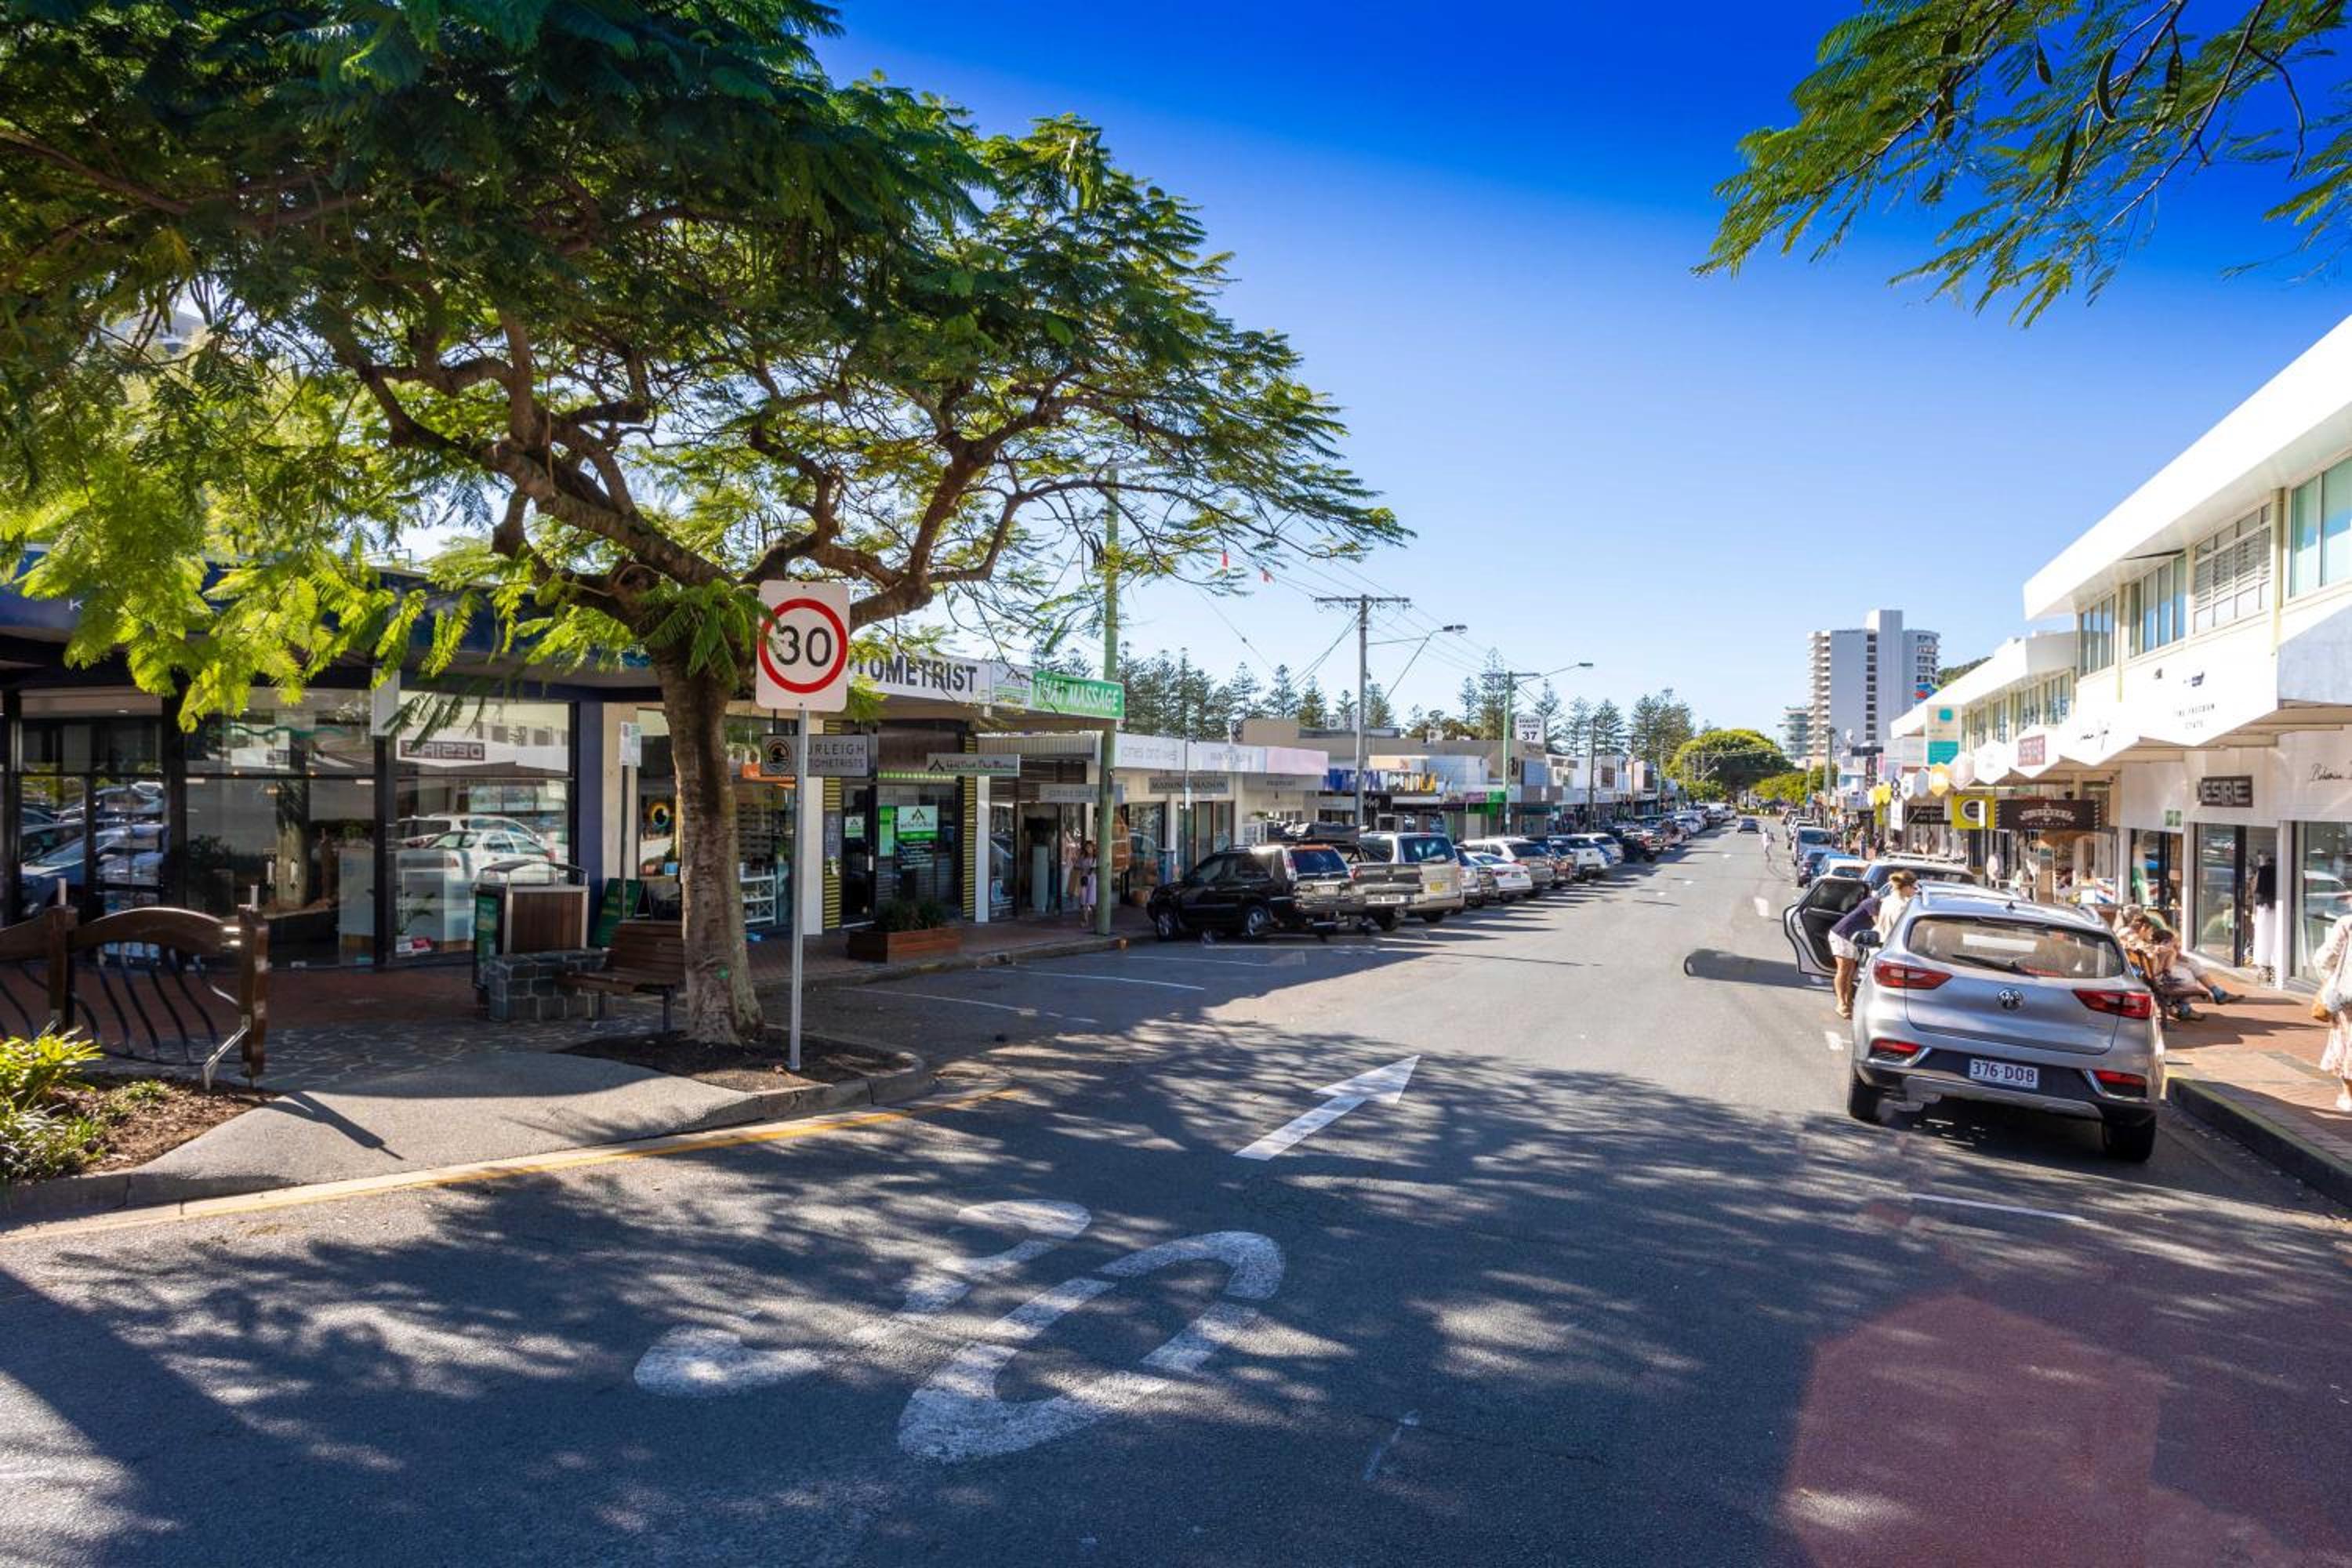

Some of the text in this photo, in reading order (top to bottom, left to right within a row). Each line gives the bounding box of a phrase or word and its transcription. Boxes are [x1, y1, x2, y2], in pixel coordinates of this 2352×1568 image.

[775, 625, 832, 667] 30
[1036, 677, 1066, 703] THAI
[1068, 683, 1120, 711] MASSAGE
[1522, 731, 1537, 741] 37
[796, 743, 866, 755] URLEIGH
[796, 758, 866, 768] TOMETRISTS
[633, 1199, 1286, 1464] 30
